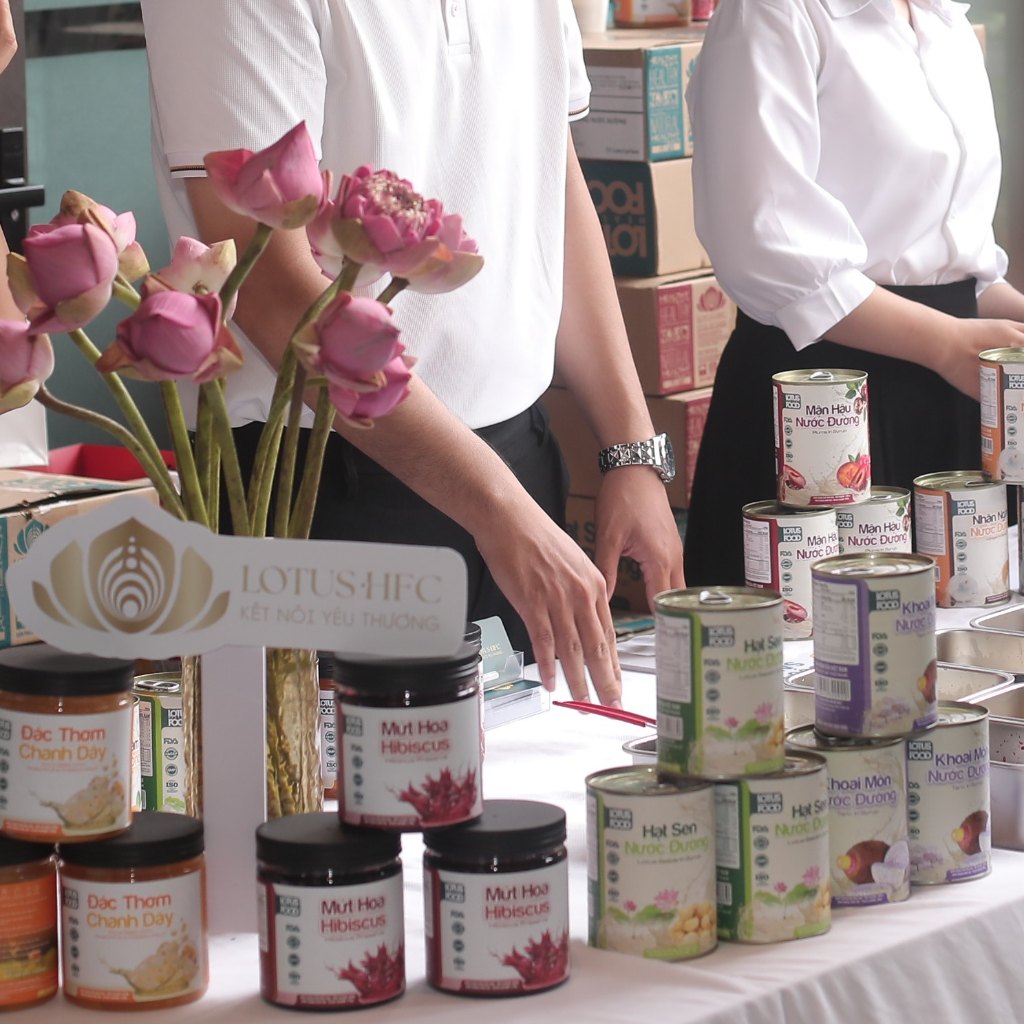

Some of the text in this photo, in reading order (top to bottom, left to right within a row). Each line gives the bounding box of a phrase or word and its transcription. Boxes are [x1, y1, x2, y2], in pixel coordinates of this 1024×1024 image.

[805, 404, 829, 418] Mận
[796, 416, 824, 427] Nước
[240, 602, 270, 623] KẾT
[321, 606, 354, 626] YÊU
[362, 611, 440, 632] THƯƠNG
[418, 719, 448, 734] Hoa
[19, 743, 73, 761] Chanh
[381, 738, 450, 754] Hibiscus
[909, 751, 932, 760] FOOD
[935, 750, 972, 766] Khoai
[672, 822, 697, 837] Sen
[522, 882, 549, 899] Hoa
[358, 896, 385, 912] Hoa
[485, 900, 550, 919] Hibiscus
[87, 911, 139, 928] Chanh
[321, 915, 386, 933] Hibiscus
